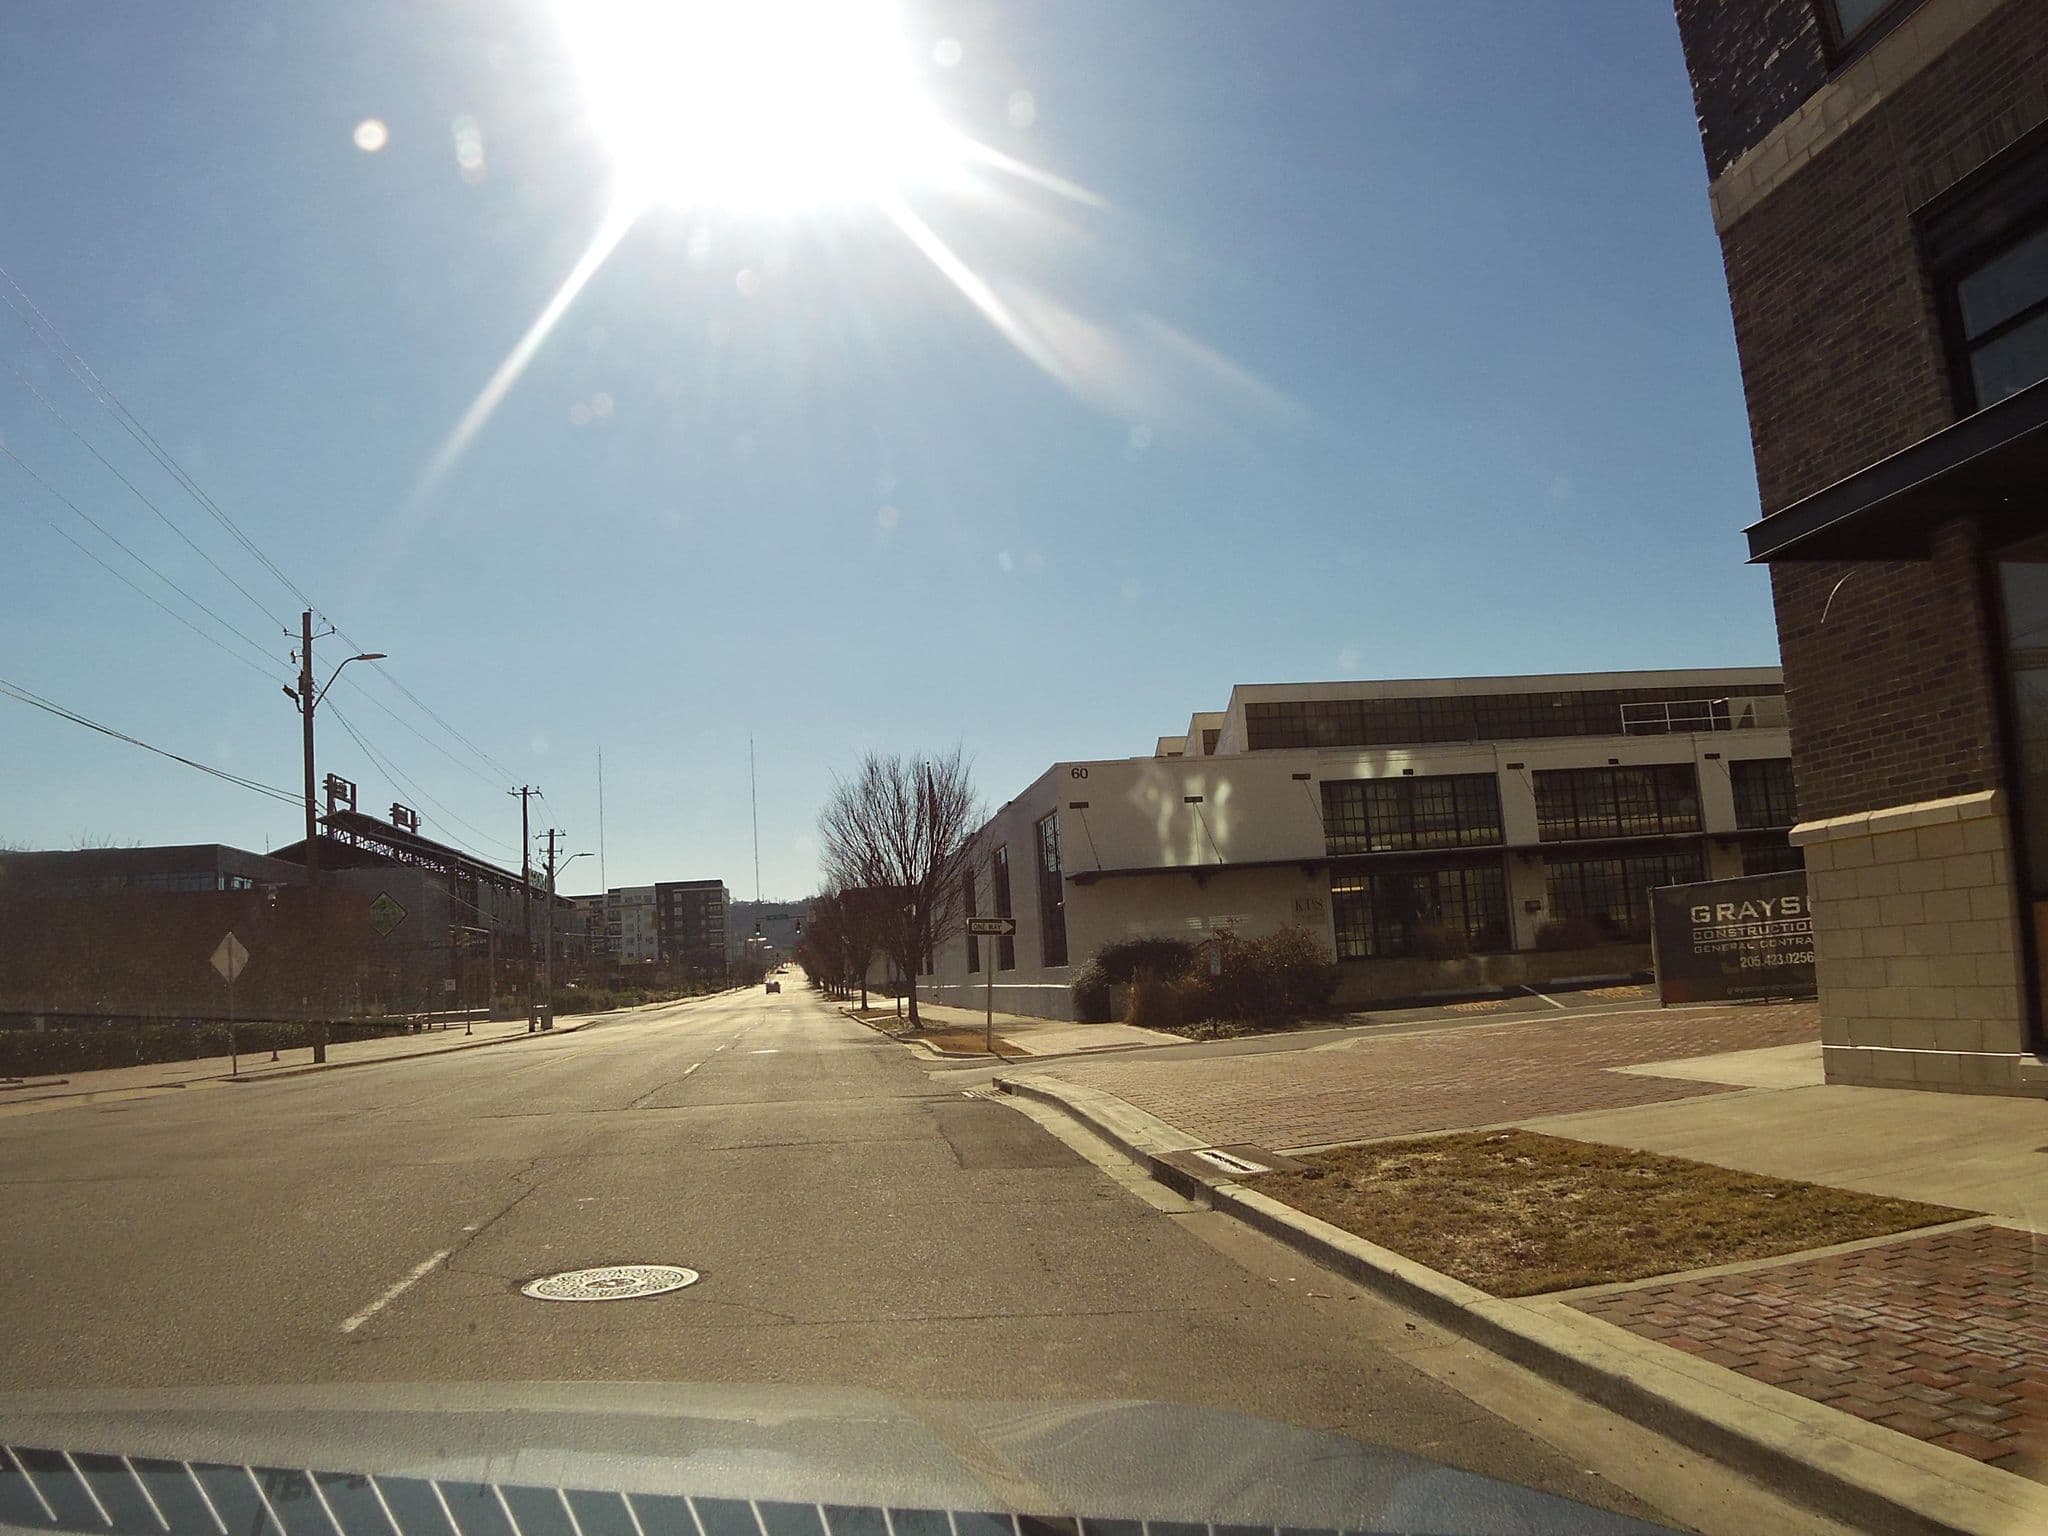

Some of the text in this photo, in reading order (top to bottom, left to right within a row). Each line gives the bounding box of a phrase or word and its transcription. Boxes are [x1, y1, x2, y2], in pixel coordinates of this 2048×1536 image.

[1071, 767, 1088, 780] 60
[1694, 942, 1755, 954] GENERAL
[1739, 951, 1815, 969] 205.423.0256
